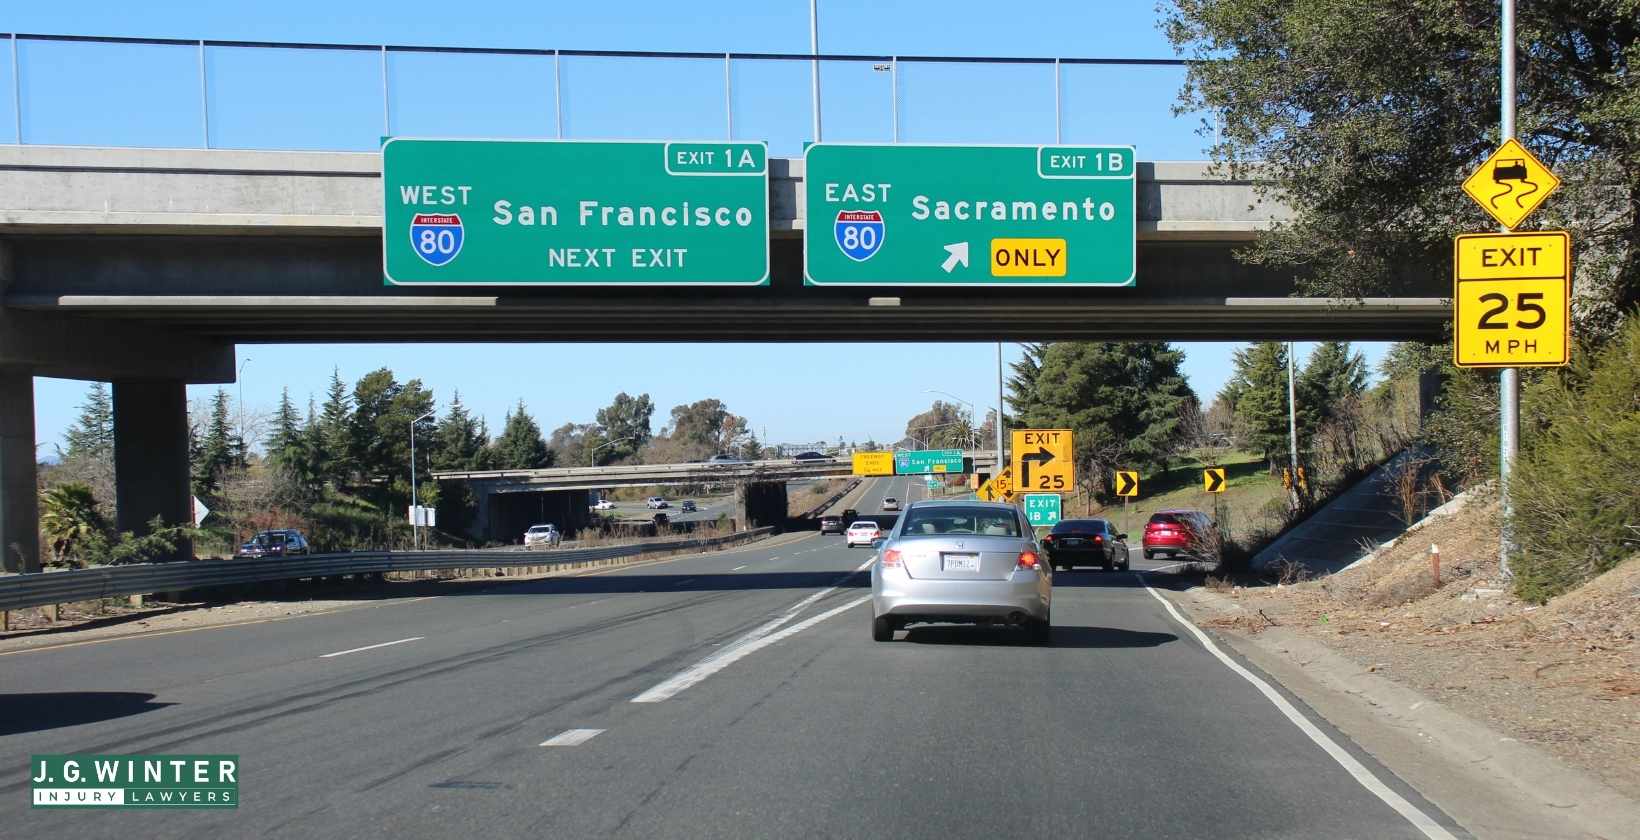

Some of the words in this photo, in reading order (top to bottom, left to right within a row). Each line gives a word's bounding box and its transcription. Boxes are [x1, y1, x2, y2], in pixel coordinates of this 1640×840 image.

[677, 151, 714, 165] EXIT
[724, 149, 756, 168] 1A
[1050, 155, 1086, 168] EXIT
[1095, 152, 1124, 171] 1B
[400, 185, 472, 206] WEST
[825, 183, 892, 203] EAST
[493, 200, 557, 226] San
[578, 200, 753, 227] Francisco
[911, 195, 1116, 222] Sacramento
[420, 229, 455, 254] 80
[843, 226, 876, 250] 80
[548, 248, 616, 268] NEXT
[631, 248, 688, 268] EXIT
[995, 248, 1061, 267] ONLY
[1482, 247, 1542, 267] EXIT
[1477, 292, 1547, 330] 25
[1485, 339, 1537, 354] MPH
[1024, 432, 1060, 445] EXIT
[996, 479, 1007, 490] 15
[1039, 474, 1065, 489] 25
[1029, 499, 1056, 507] EXIT
